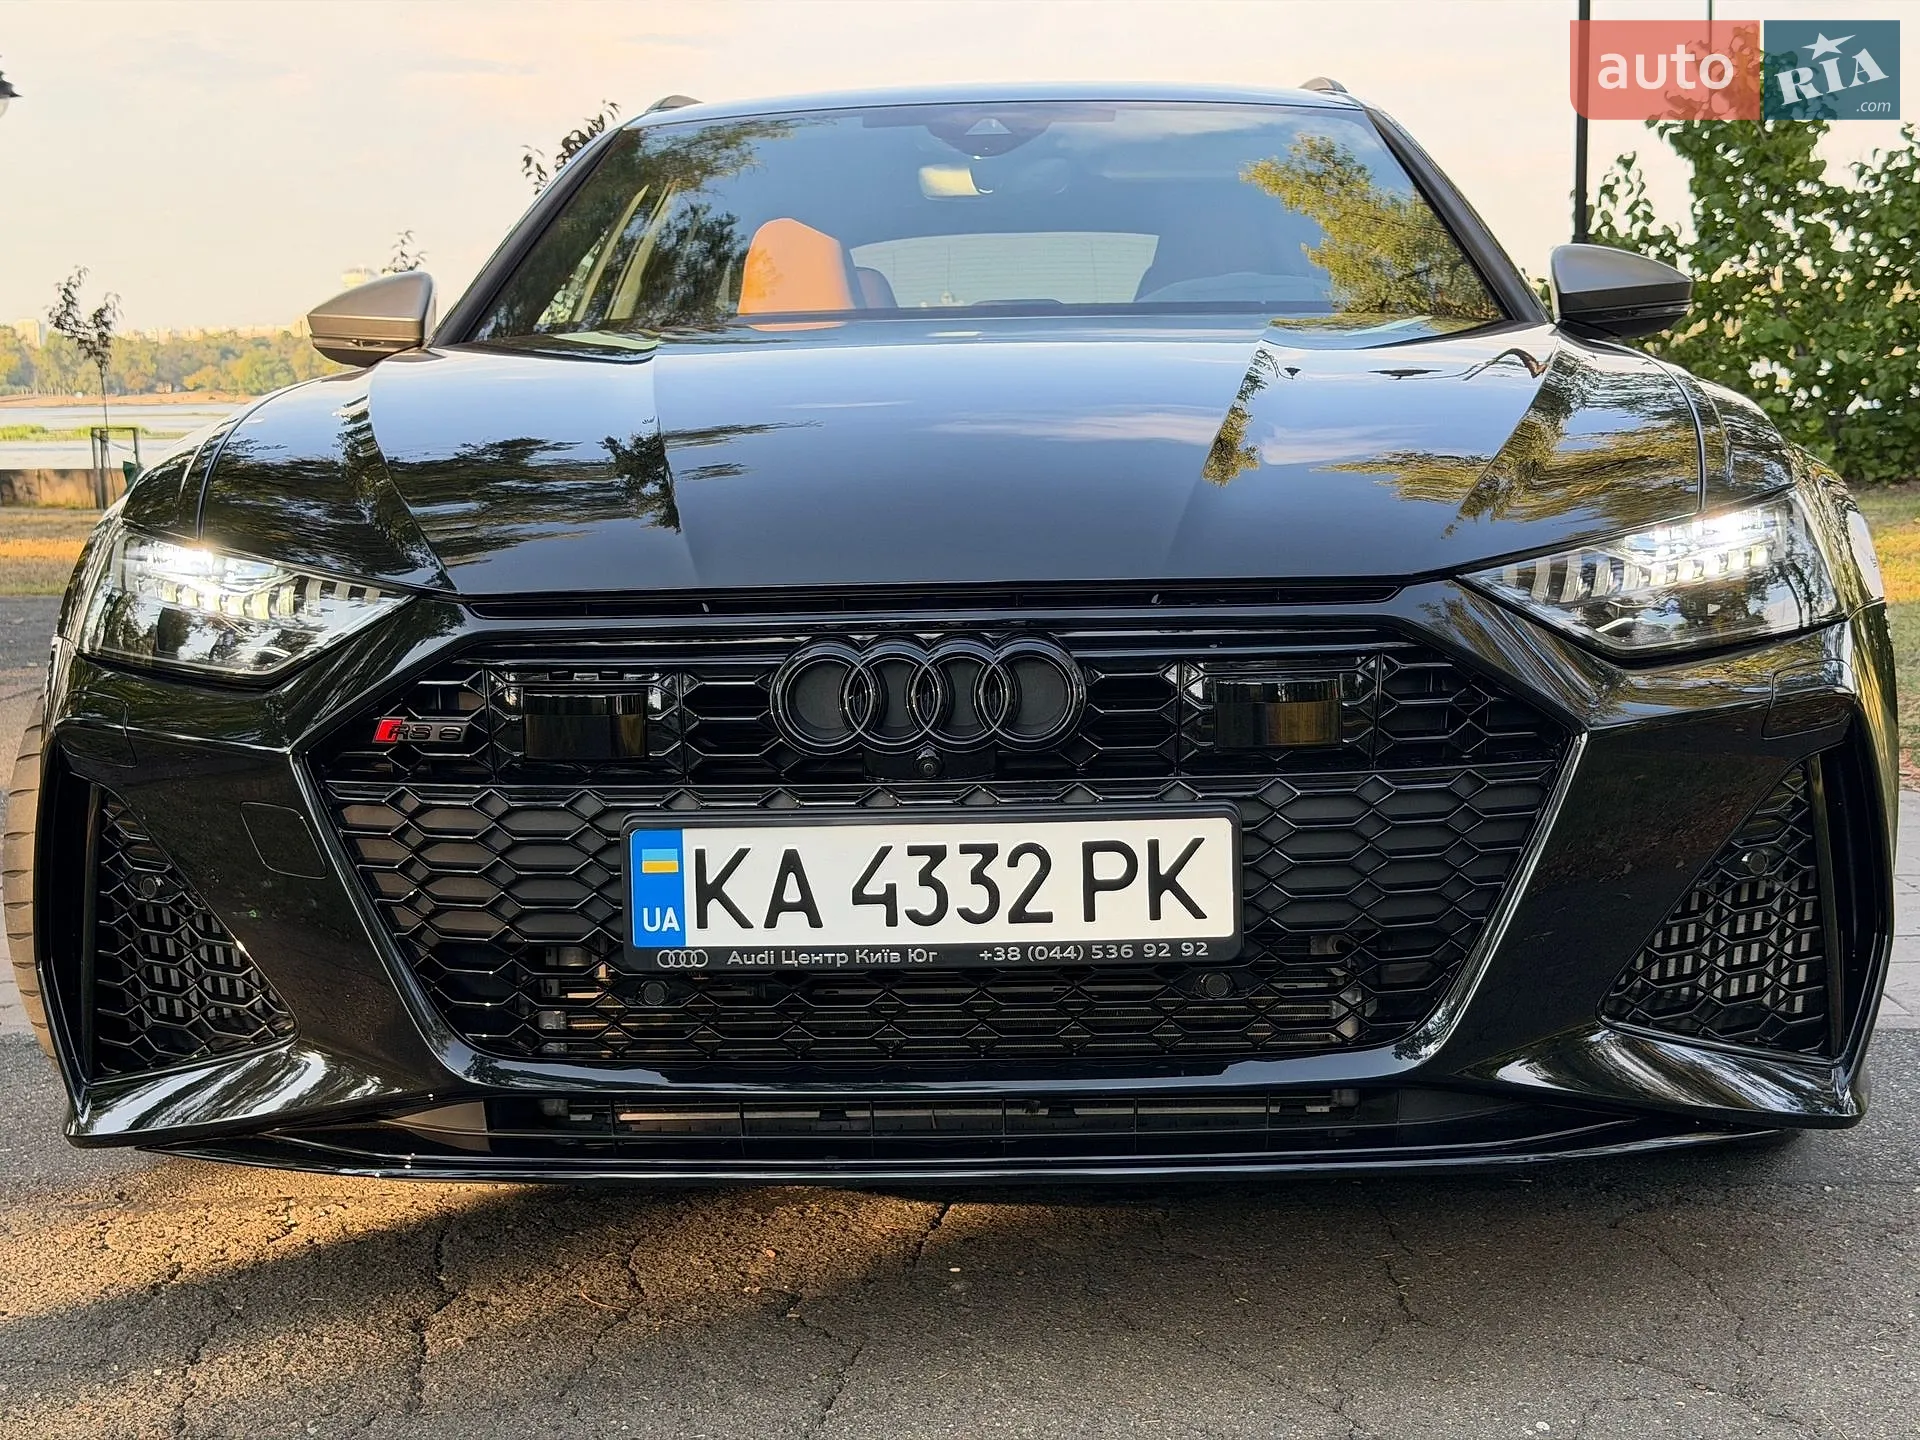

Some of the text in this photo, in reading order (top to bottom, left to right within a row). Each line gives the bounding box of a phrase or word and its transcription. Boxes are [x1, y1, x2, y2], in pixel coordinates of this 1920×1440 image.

[694, 836, 1209, 929] KA 4332 PK
[641, 906, 681, 933] UA
[726, 948, 938, 967] Audi Центр Київ Юг
[979, 941, 1209, 962] +38 (044) 536 92 92
